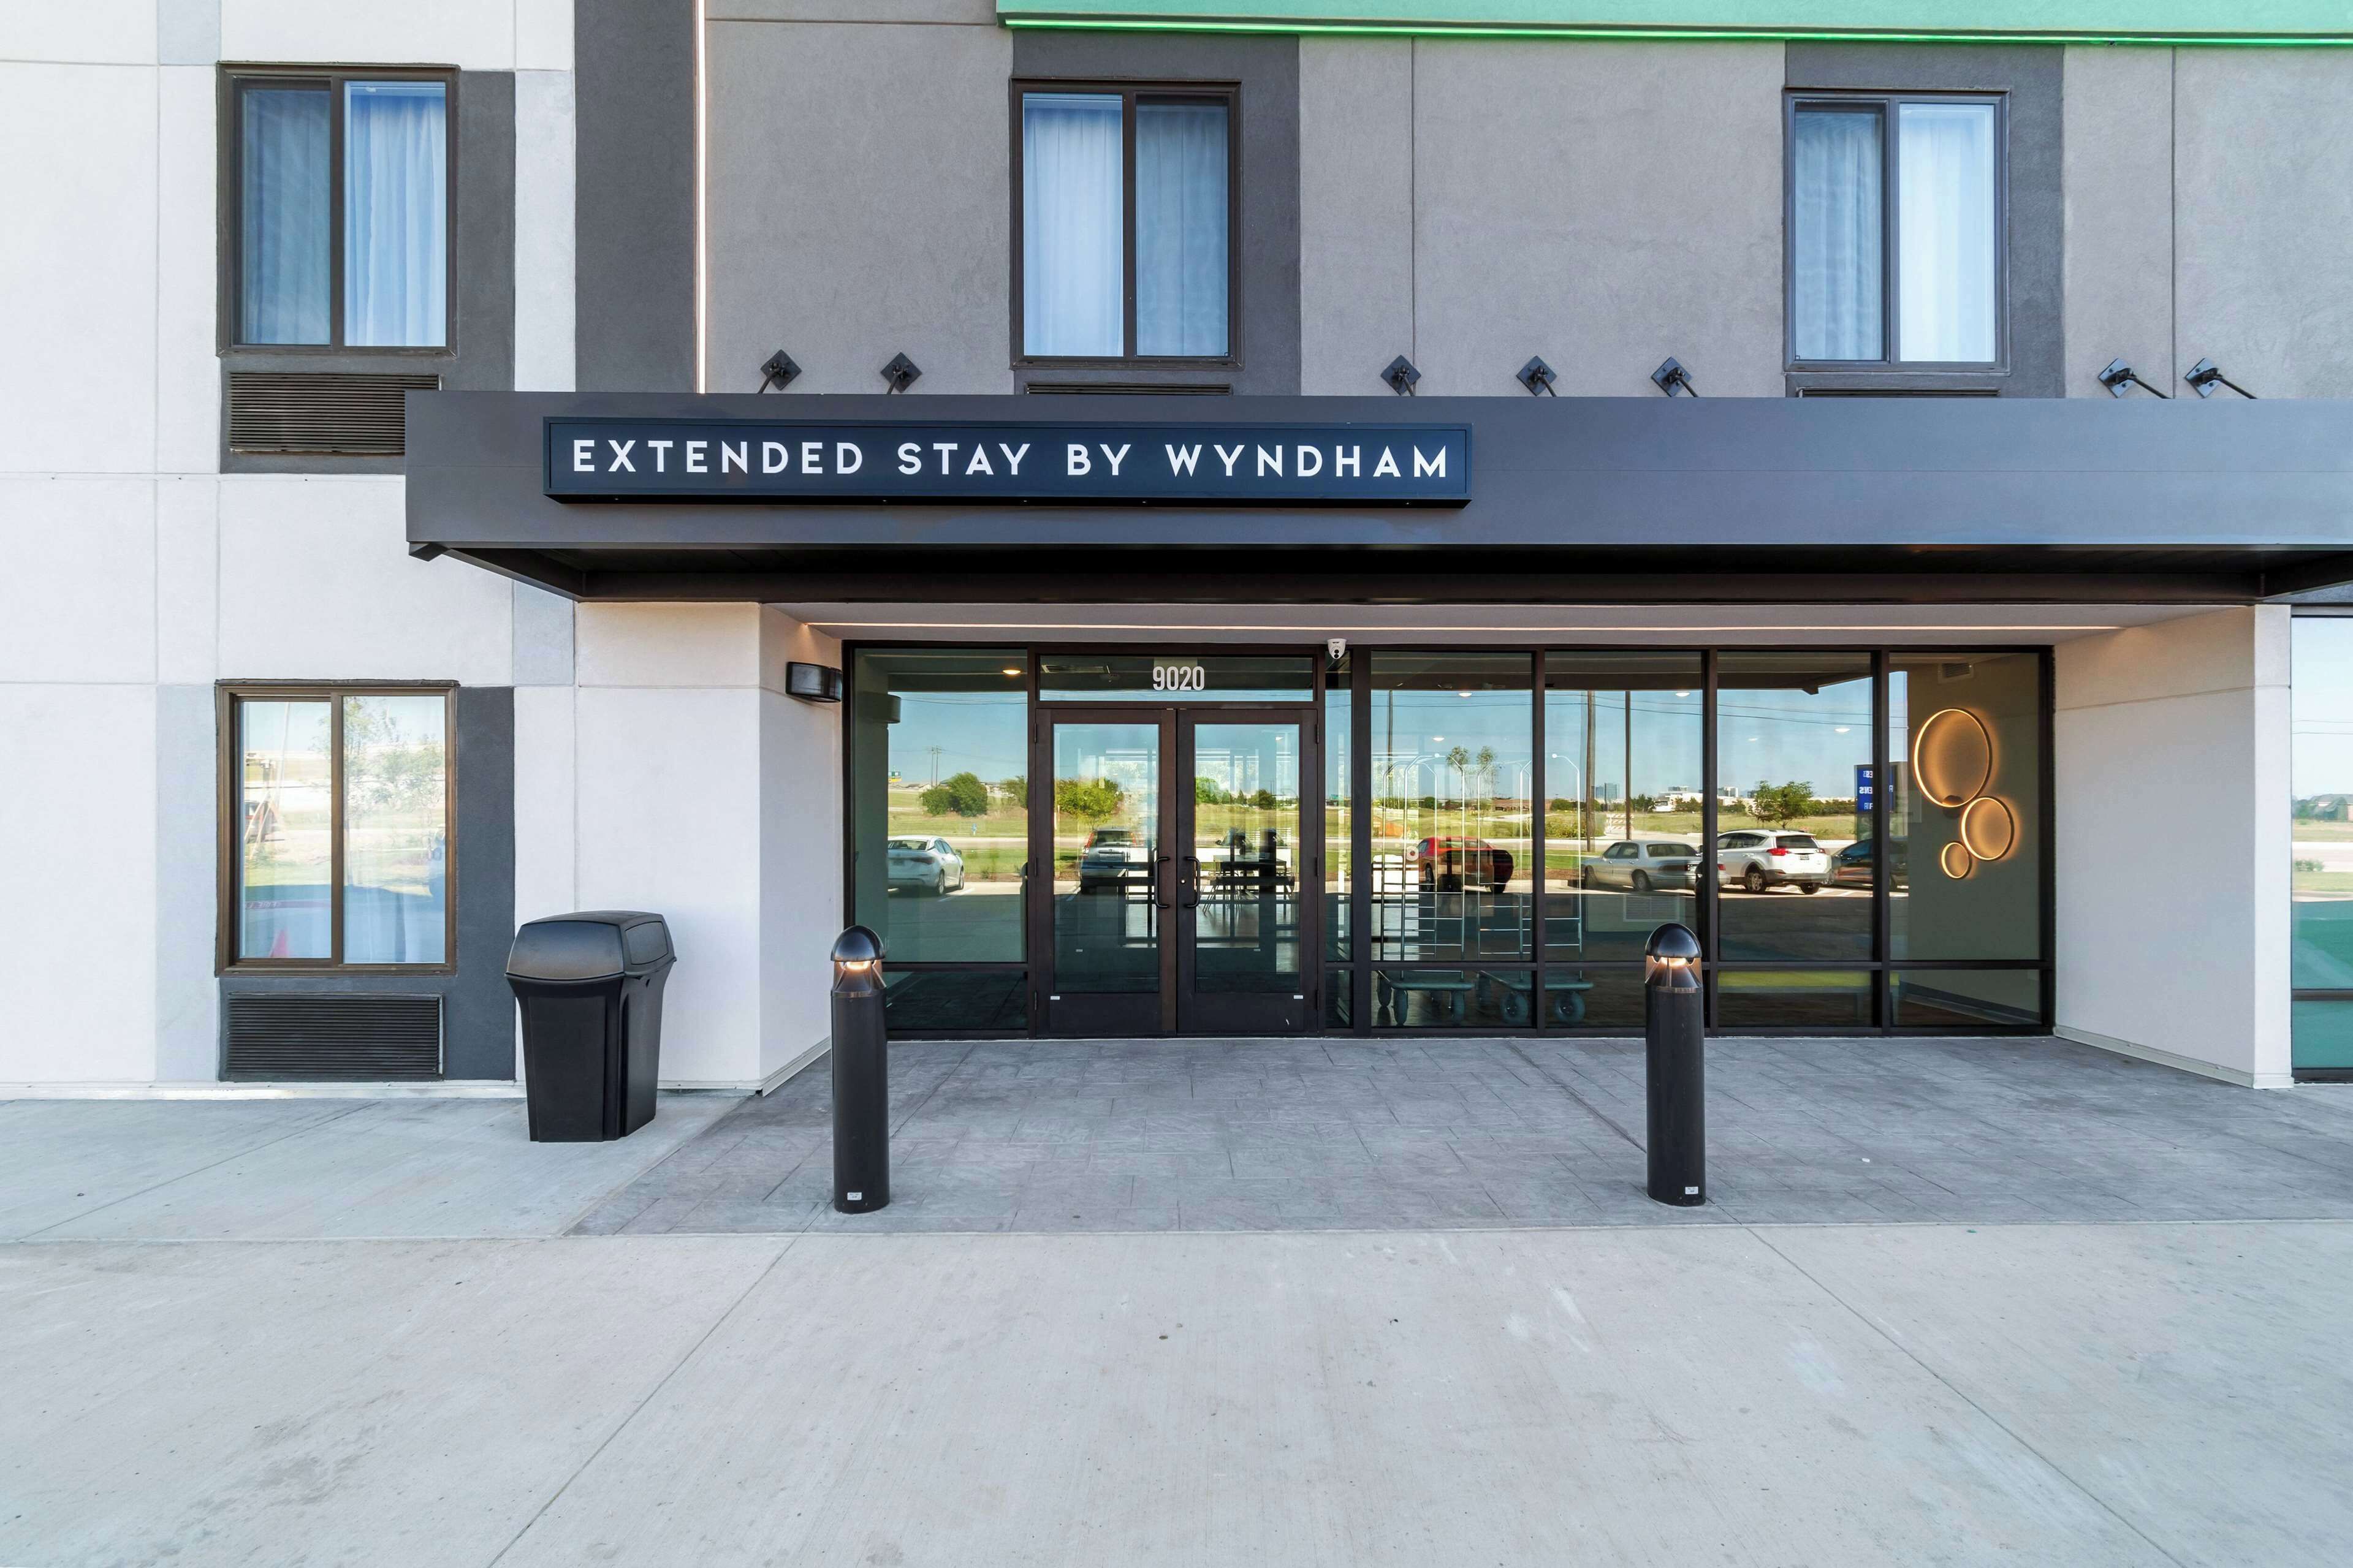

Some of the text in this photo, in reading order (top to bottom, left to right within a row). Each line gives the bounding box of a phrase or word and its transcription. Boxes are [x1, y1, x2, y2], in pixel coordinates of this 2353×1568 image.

[574, 439, 1446, 478] EXTENDED STAY BY WYNDHAM
[1152, 666, 1204, 691] 9020
